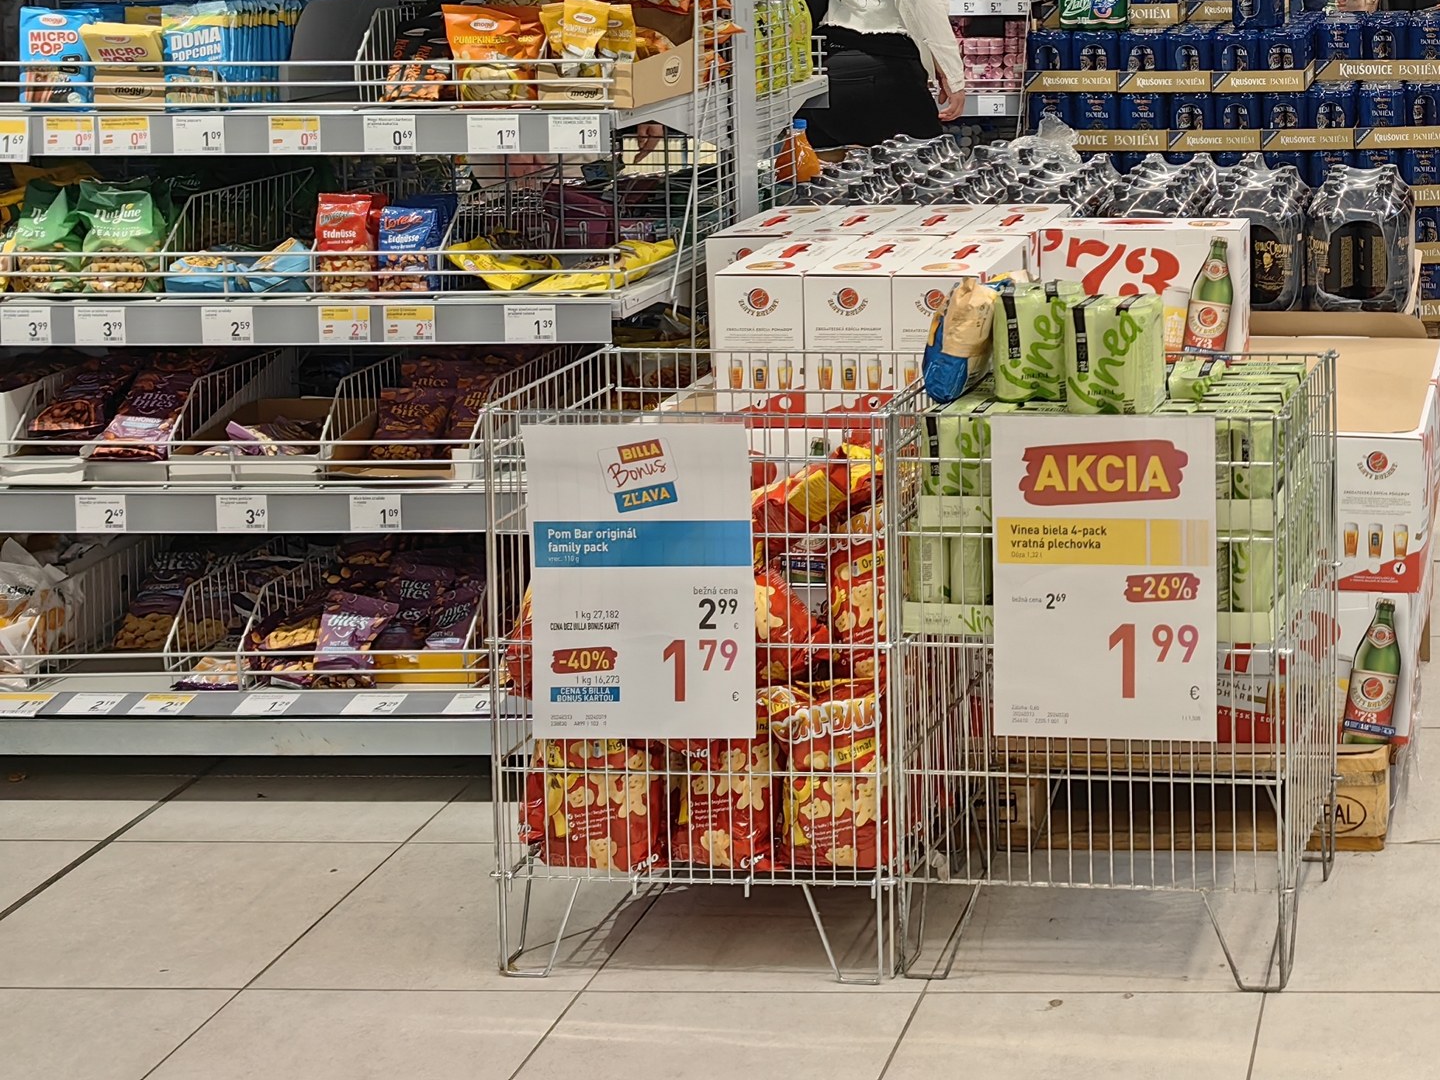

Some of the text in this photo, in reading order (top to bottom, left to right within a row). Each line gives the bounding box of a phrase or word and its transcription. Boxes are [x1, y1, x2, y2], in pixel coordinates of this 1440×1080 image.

[29, 30, 78, 43] MICRO
[170, 26, 220, 51] DOMA
[30, 42, 63, 55] POP
[99, 46, 147, 58] MICRO
[171, 44, 222, 62] POPCORN
[1339, 62, 1393, 79] KRUŠOVICE
[1042, 76, 1079, 86] KRUŠOVICE
[1136, 76, 1172, 87] KRUŠOVICE
[1230, 76, 1266, 87] KRUŠOVICE
[1114, 132, 1159, 147] BOHÉM
[1186, 135, 1223, 145] KRUŠOVICE
[1280, 134, 1316, 145] KRUŠOVICE
[1374, 132, 1410, 142] KRUŠOVICE
[91, 227, 143, 239] PEANUTS
[322, 229, 357, 239] Erdnüsse
[387, 233, 420, 244] Erdnüsse
[621, 442, 661, 463] BILLA
[607, 459, 667, 488] Bonus
[1033, 454, 1172, 493] AKCIA
[622, 487, 672, 508] ZĽAVA
[547, 527, 637, 542] Pom Bar originál
[1010, 523, 1108, 538] Vinea biela 4-pack
[548, 541, 609, 556] family pack
[1010, 537, 1101, 552] vratná plechovka
[692, 586, 739, 596] bežná cena
[1131, 575, 1193, 600] -26%
[580, 610, 591, 621] kg
[592, 610, 620, 621] 27,182
[604, 622, 620, 631] KARTY
[558, 650, 610, 670] -40%
[580, 675, 592, 686] kg
[593, 675, 620, 685] 16,273
[560, 687, 580, 695] CENA
[588, 687, 610, 695] BILLA
[1189, 685, 1201, 700] €
[556, 694, 581, 702] BONUS
